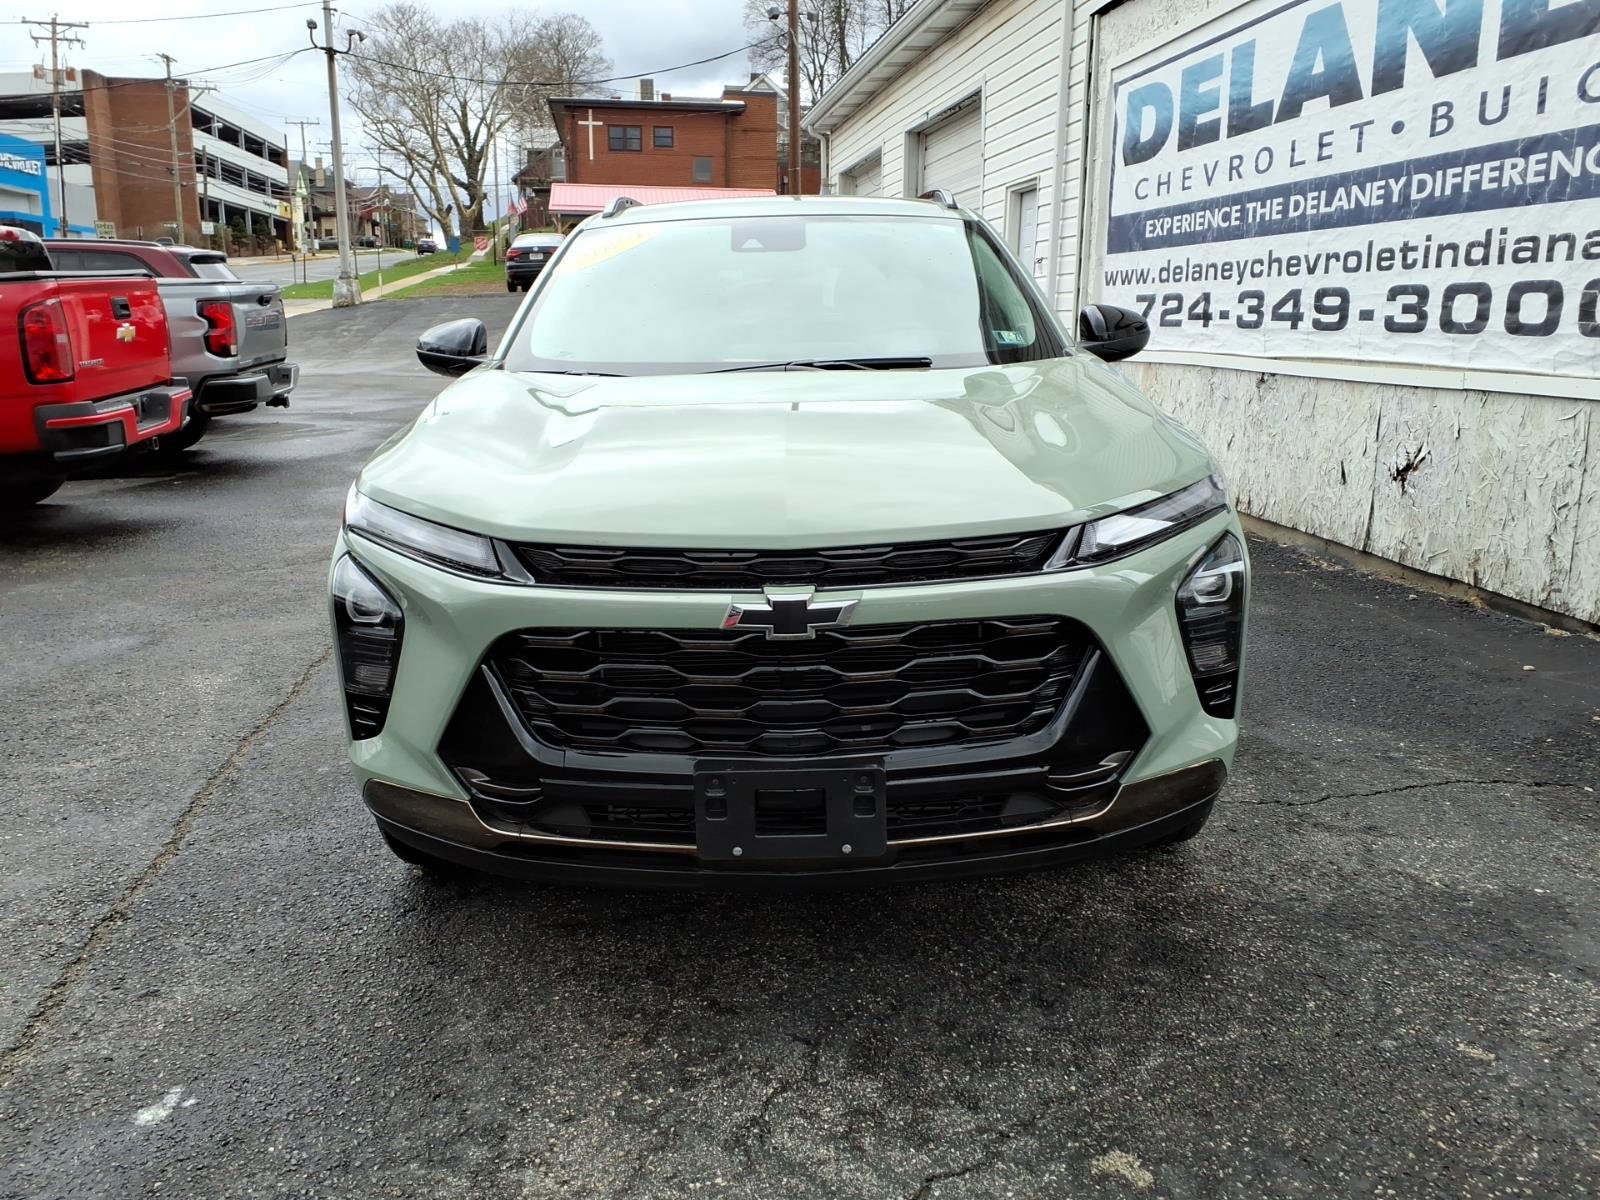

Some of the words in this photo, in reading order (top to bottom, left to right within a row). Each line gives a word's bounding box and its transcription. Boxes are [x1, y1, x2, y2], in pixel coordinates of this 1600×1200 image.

[1134, 119, 1375, 201] CHEVROLET
[1145, 203, 1241, 239] EXPERIENCE
[1246, 197, 1284, 224] THE
[1288, 175, 1408, 219] DELANEY
